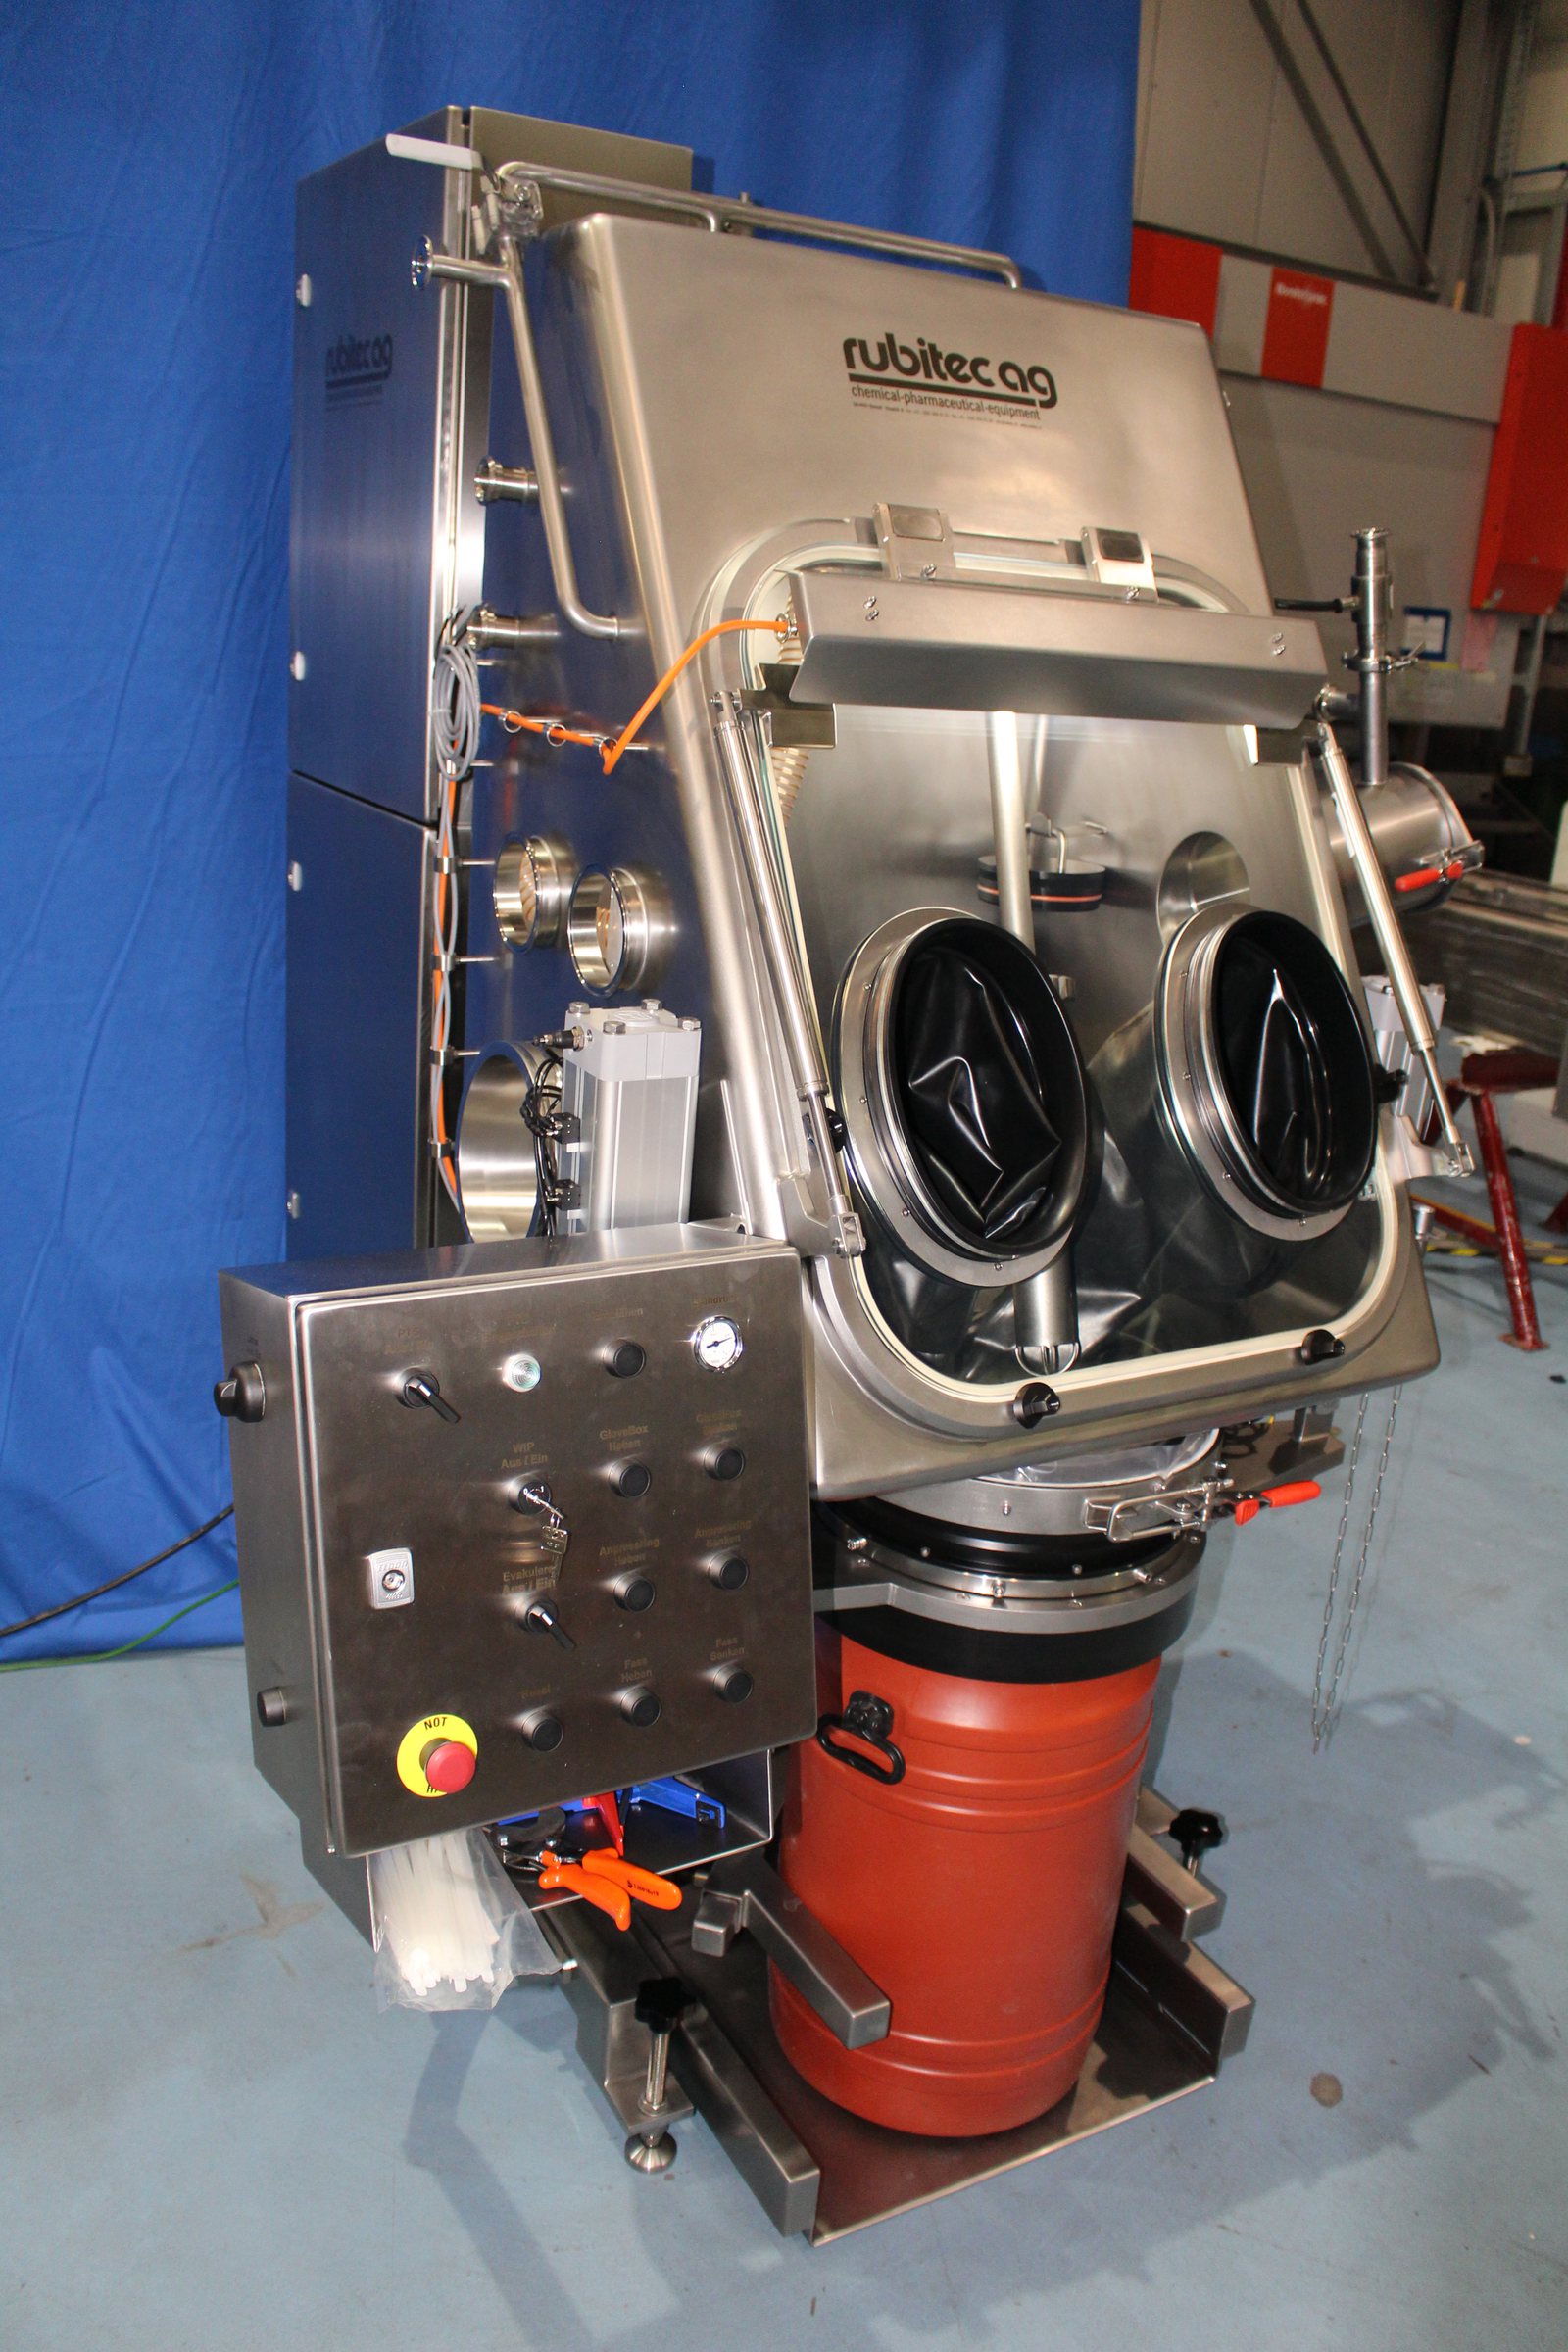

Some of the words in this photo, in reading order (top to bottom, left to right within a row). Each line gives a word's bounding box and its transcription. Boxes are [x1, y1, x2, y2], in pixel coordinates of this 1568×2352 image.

[843, 332, 995, 387] rubitec
[998, 361, 1058, 409] ag
[851, 385, 1041, 420] chemical-pharmaceutical-equipment
[512, 1442, 535, 1453] WIP
[530, 1453, 549, 1465] Ein
[423, 1717, 449, 1731] NOT
